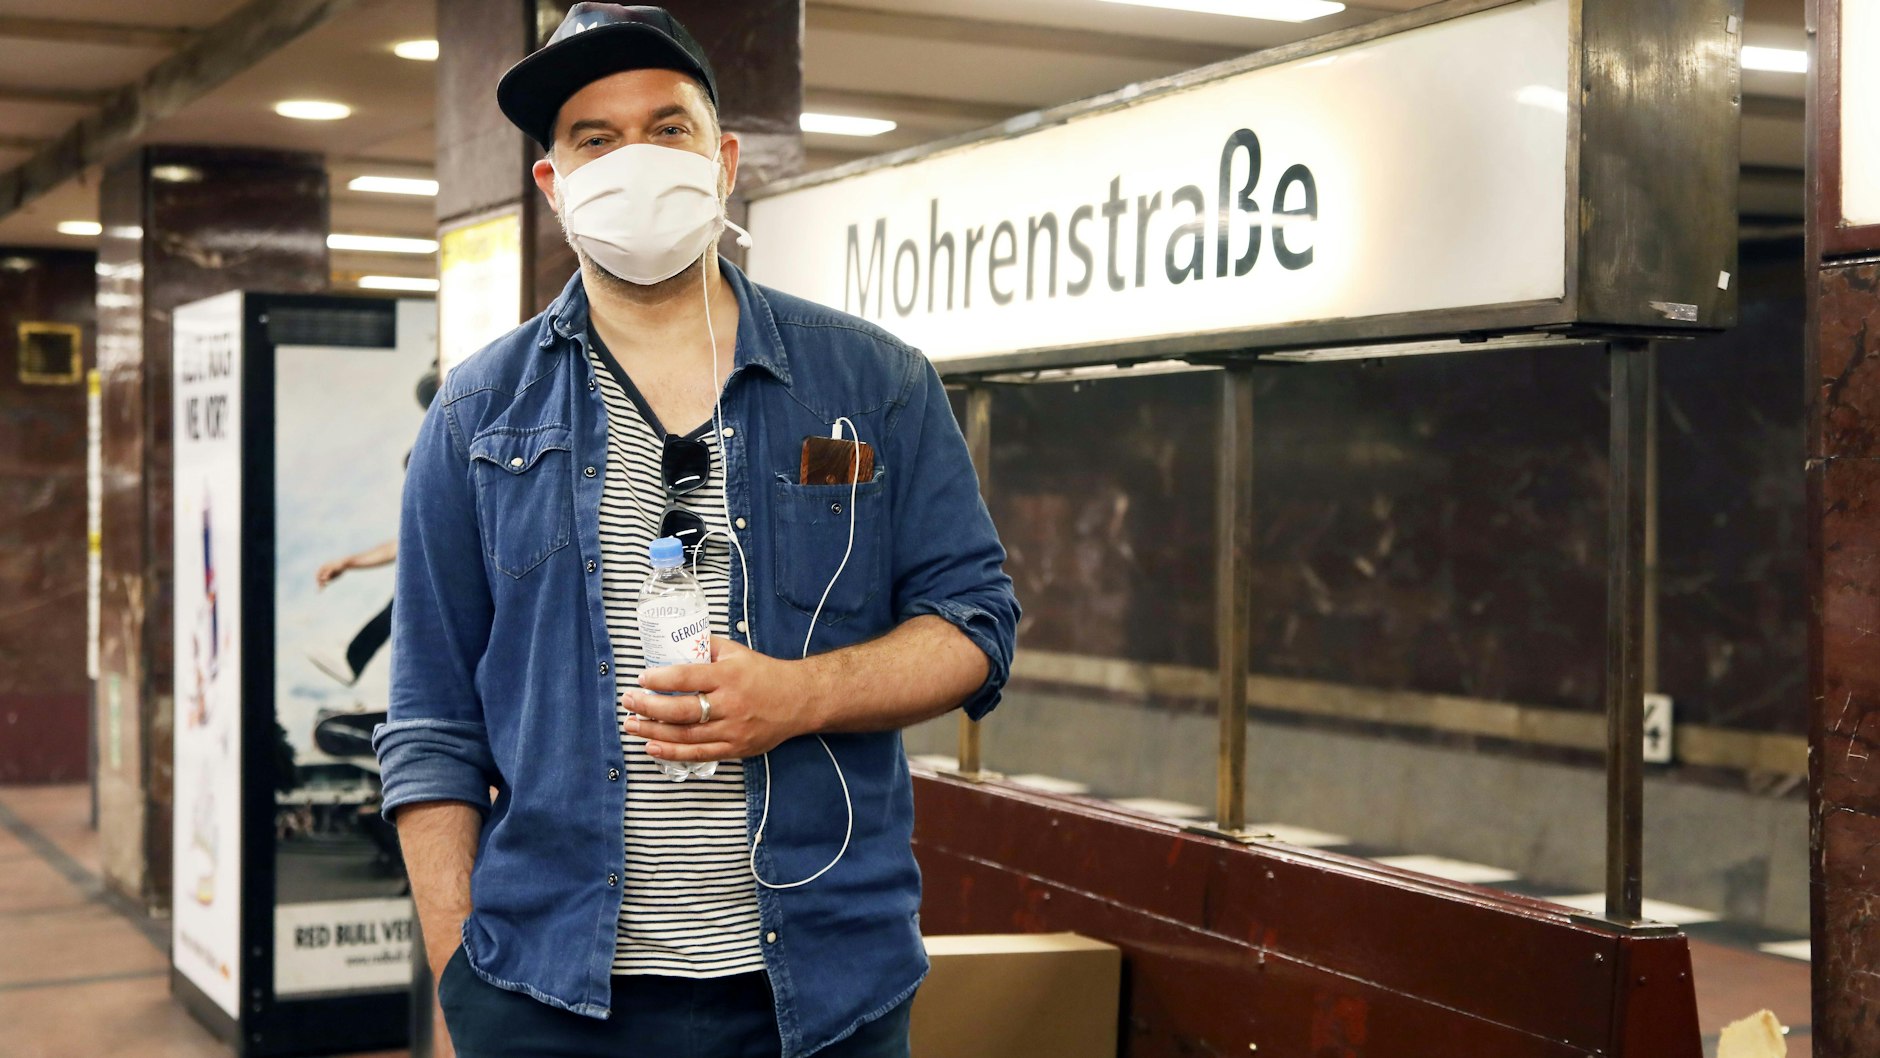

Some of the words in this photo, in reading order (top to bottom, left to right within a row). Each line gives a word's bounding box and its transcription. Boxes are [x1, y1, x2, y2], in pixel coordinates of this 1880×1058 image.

[844, 128, 1318, 319] Mohrenstraße
[294, 924, 329, 948] RED
[335, 921, 376, 946] BULL
